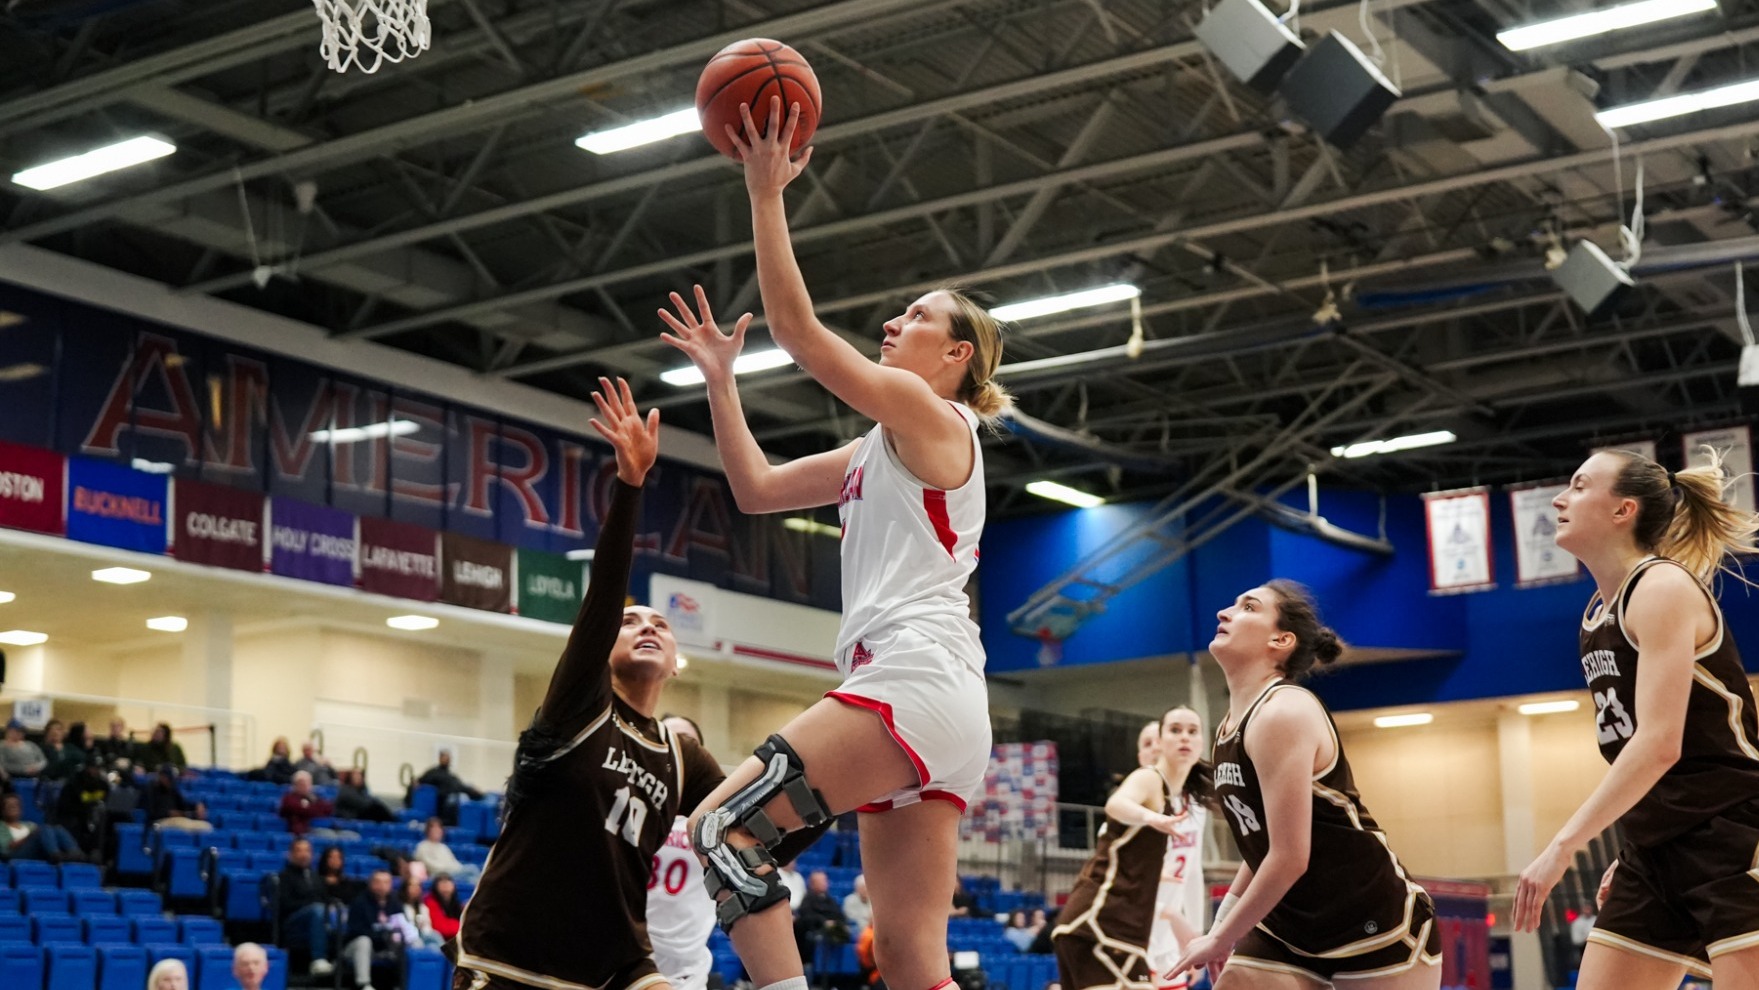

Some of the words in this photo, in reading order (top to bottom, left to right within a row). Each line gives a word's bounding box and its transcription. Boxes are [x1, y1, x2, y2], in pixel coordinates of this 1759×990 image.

[73, 485, 162, 526] BUCKNELL
[182, 511, 258, 547] COLGATE
[273, 524, 308, 554] HOLY
[362, 543, 437, 579] LAFAYETTE
[453, 559, 503, 590] LEHIGH
[526, 573, 576, 600] LOYOLA
[1594, 687, 1634, 745] 23
[604, 786, 648, 848] 10
[1222, 794, 1262, 837] 19
[1173, 854, 1187, 879] 2
